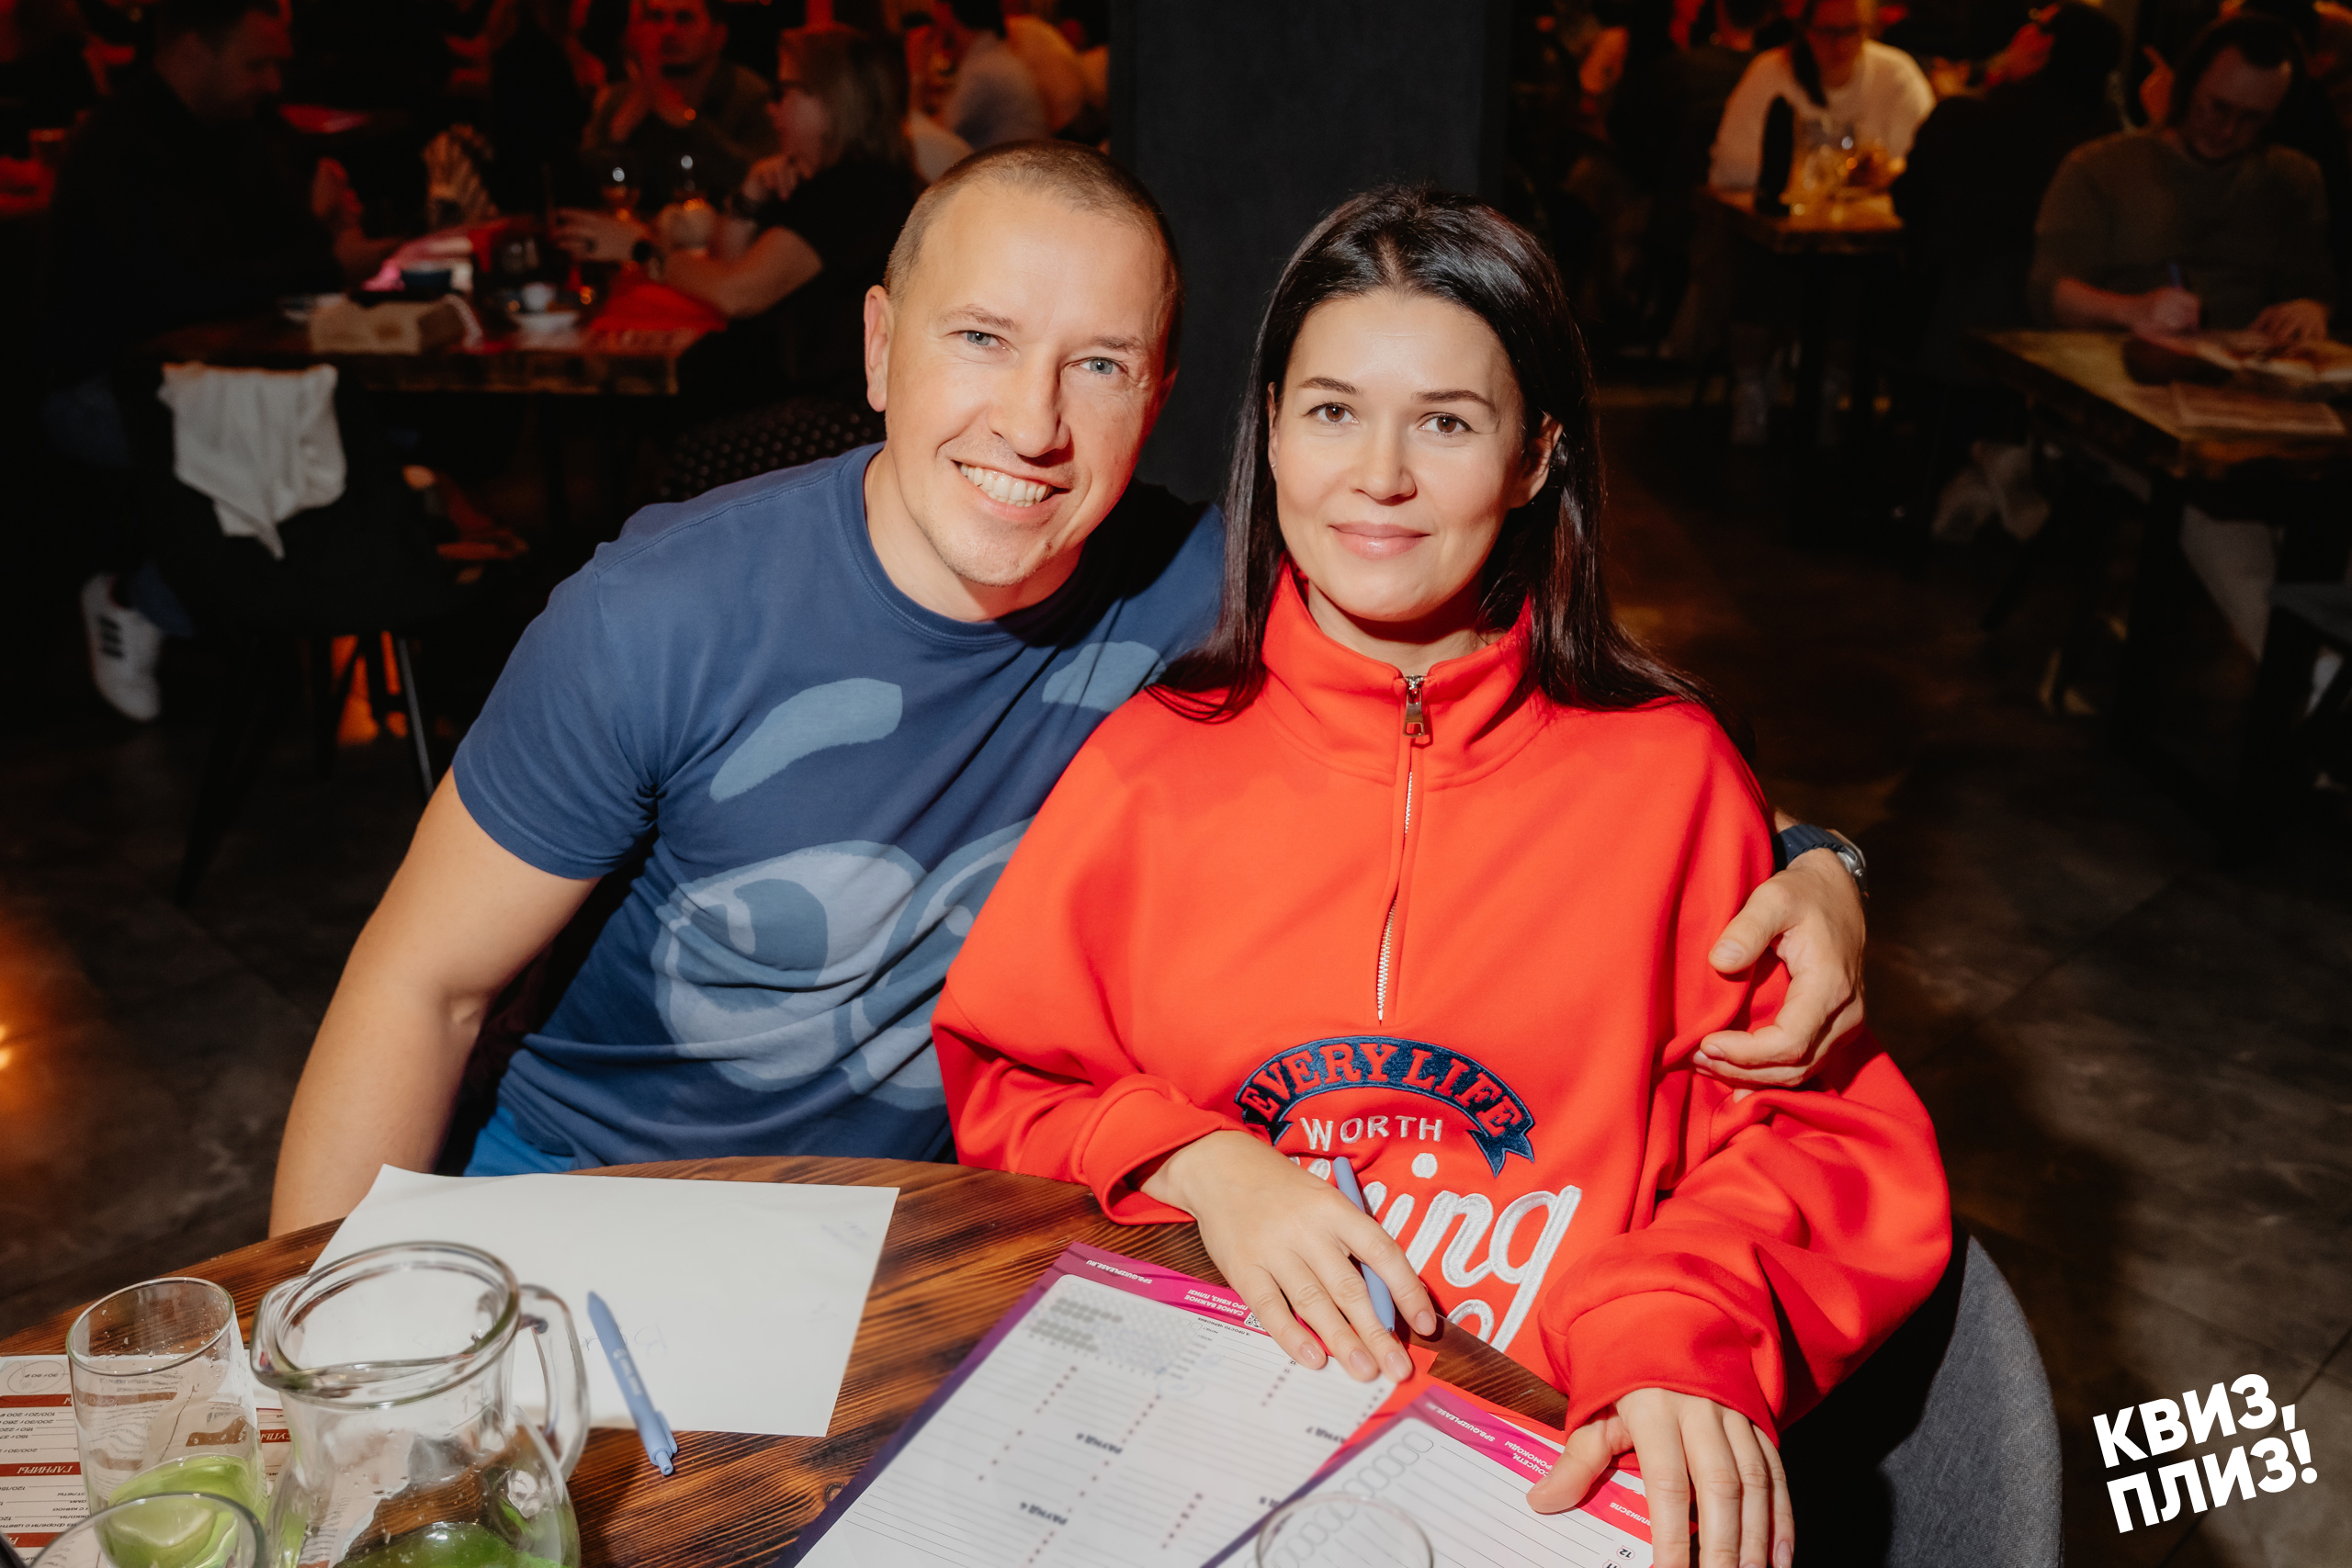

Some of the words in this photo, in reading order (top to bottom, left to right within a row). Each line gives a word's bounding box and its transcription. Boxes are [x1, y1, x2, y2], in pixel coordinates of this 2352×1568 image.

[1240, 1042, 1398, 1122] EVERY
[1402, 1050, 1523, 1136] LIFE
[1300, 1114, 1443, 1152] WORTH
[1085, 1259, 1153, 1284] SPB.QUIZPLEASE.RU
[1183, 1294, 1217, 1309] ВАЖНОЕ
[1187, 1289, 1210, 1300] ПЛИЗ!
[1211, 1295, 1232, 1306] КВИЗ,
[1216, 1304, 1244, 1316] САМОЕ
[1232, 1302, 1249, 1311] ПРО
[1425, 1402, 1496, 1442] SPB.QUIZPLEASE.RU
[1315, 1427, 1348, 1445] АУНД
[1504, 1440, 1553, 1470] РОМОКОДЫ
[16, 1465, 74, 1474] ГАРНИРЫ
[1027, 1504, 1069, 1526] РАУНД
[1619, 1548, 1633, 1559] 12
